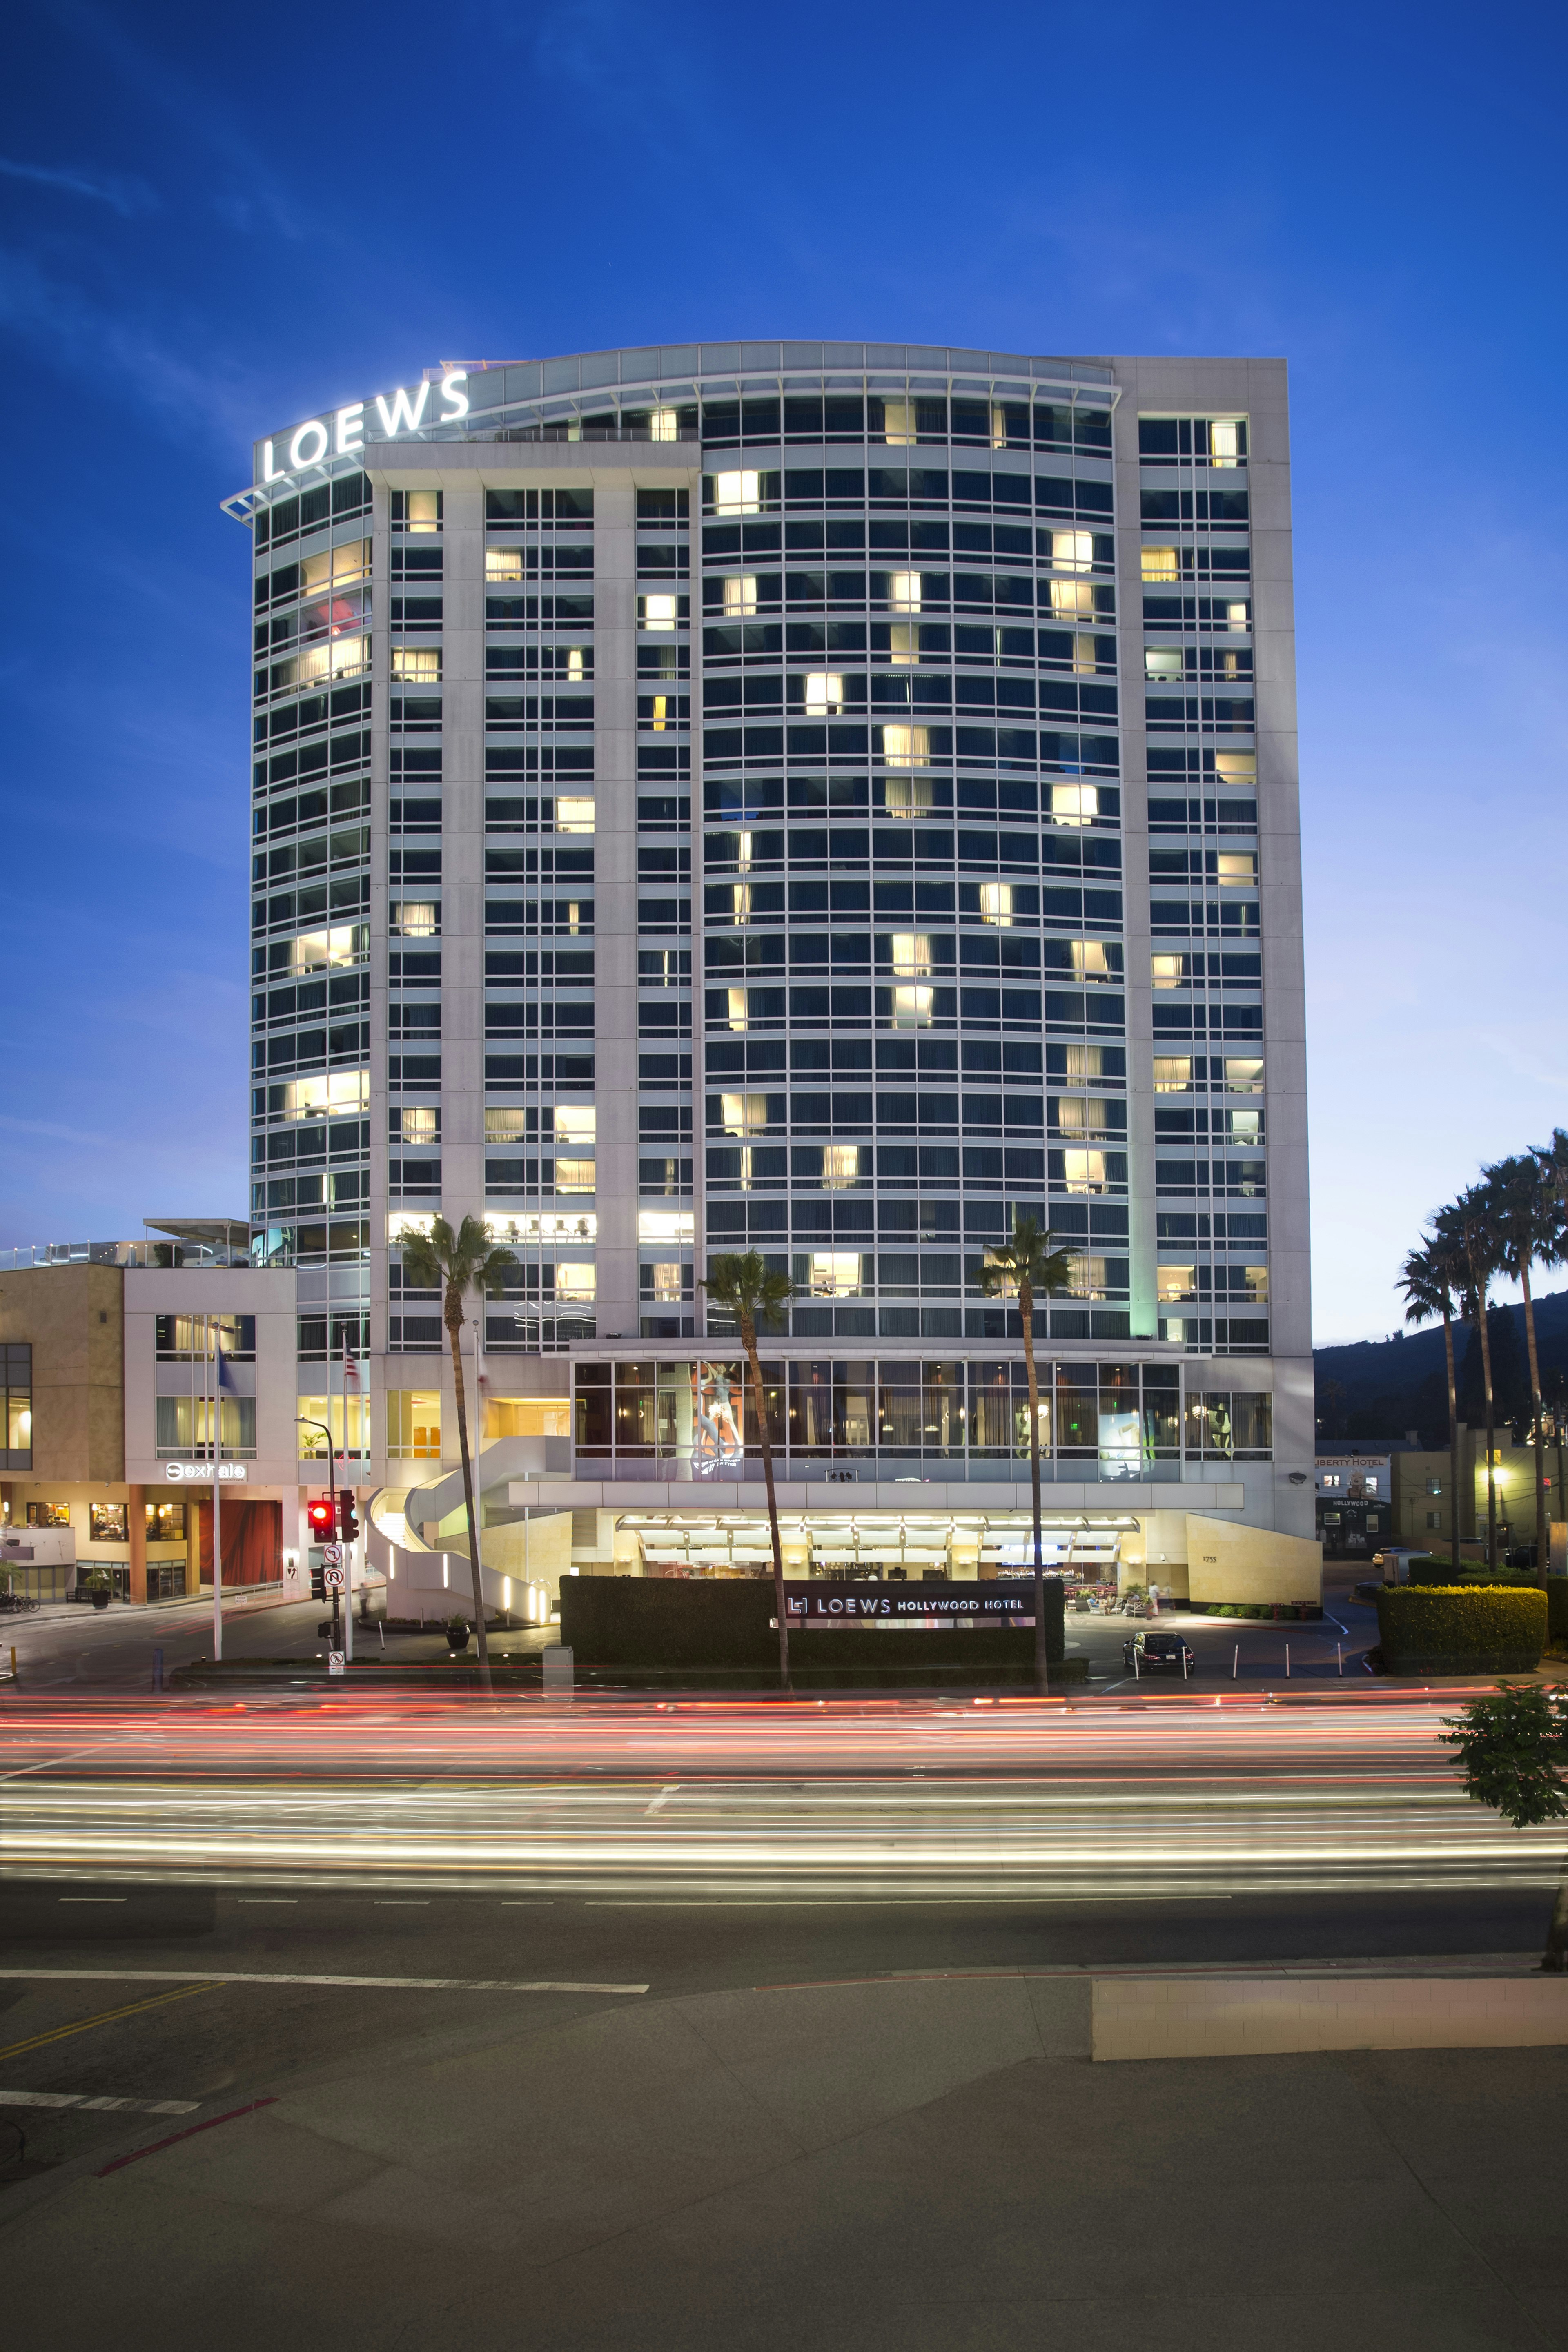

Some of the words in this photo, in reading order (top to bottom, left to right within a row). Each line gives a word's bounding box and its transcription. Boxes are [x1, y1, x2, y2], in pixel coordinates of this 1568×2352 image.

[265, 371, 469, 482] LOEWS
[184, 1463, 245, 1478] exhale
[817, 1599, 890, 1613] LOEWS
[898, 1601, 980, 1611] HOLLYWOOD
[984, 1600, 1024, 1610] HOTEL
